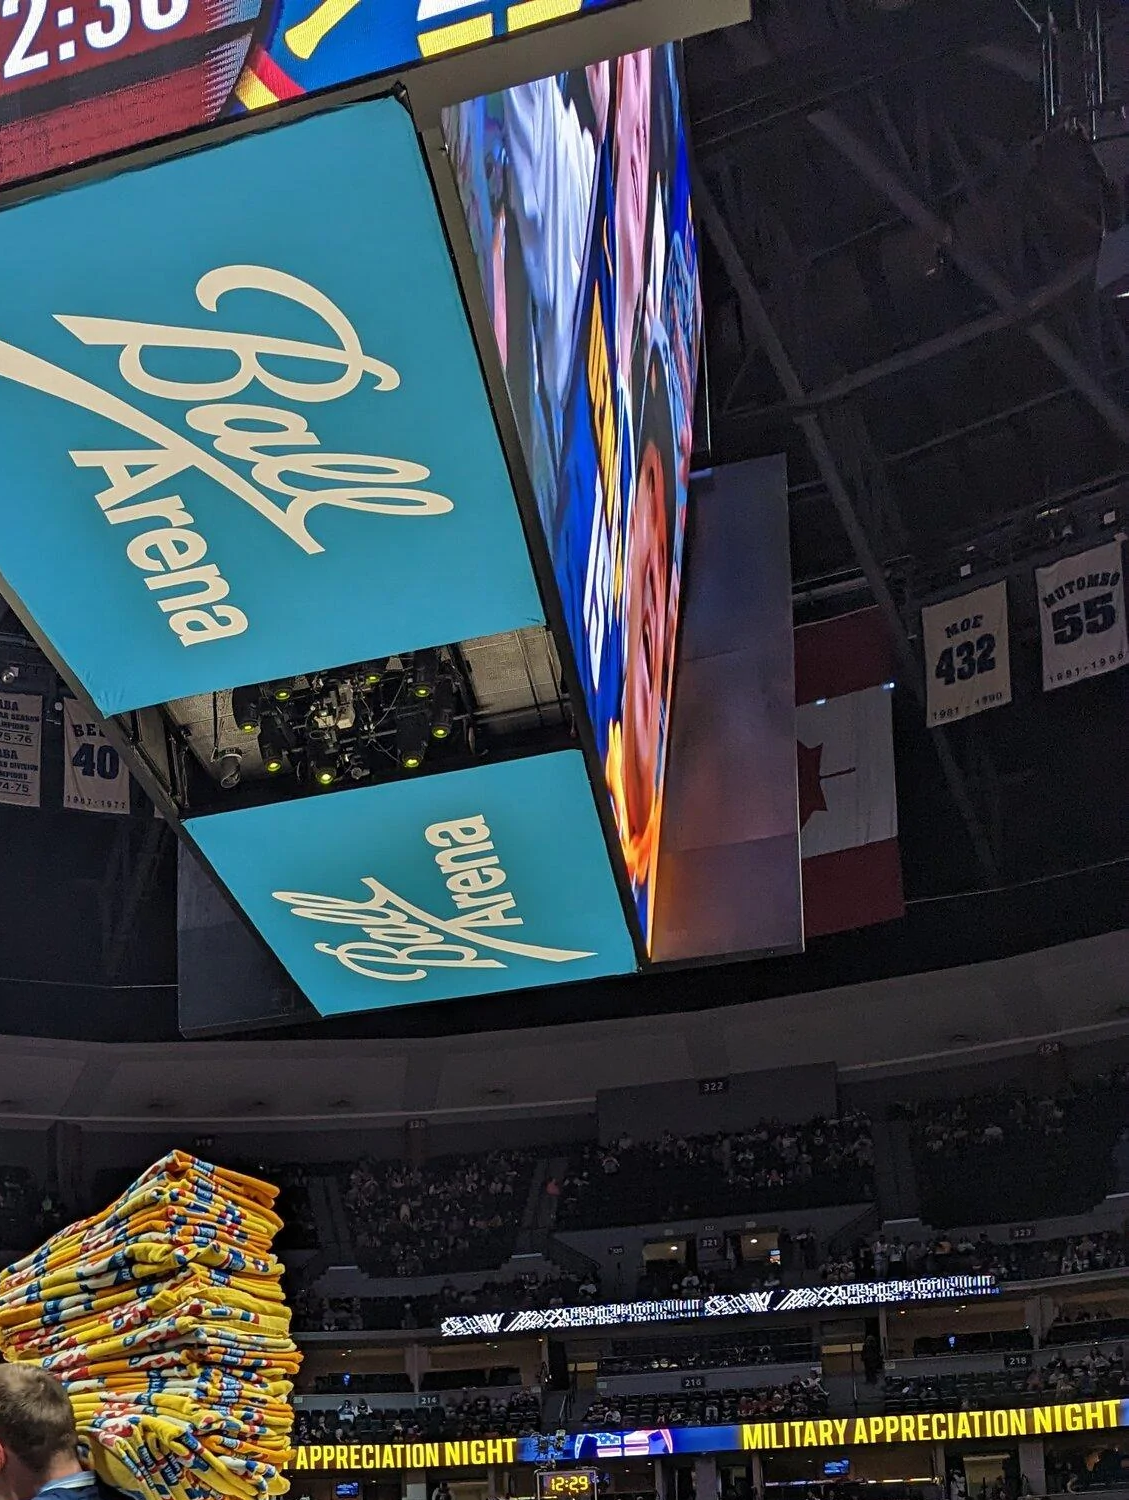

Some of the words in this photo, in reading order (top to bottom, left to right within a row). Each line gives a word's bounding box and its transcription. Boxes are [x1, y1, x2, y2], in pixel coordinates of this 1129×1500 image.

[52, 264, 455, 545] Ball
[68, 448, 249, 648] Arena
[1042, 571, 1121, 609] MUTOMBO
[944, 614, 984, 639] MOE
[1051, 592, 1117, 646] 55
[935, 633, 997, 686] 432
[10, 761, 39, 772] DIVISION
[73, 742, 120, 780] 40
[424, 813, 524, 928] Arena
[271, 879, 508, 982] Ball
[704, 1082, 723, 1091] 322
[702, 1239, 717, 1247] 321
[1010, 1357, 1027, 1365] 218
[743, 1419, 850, 1451] MILITARY
[854, 1409, 1027, 1444] APPRECIATION
[1034, 1399, 1122, 1433] NIGHT
[296, 1442, 439, 1470] APPRECIATION
[445, 1437, 518, 1467] NIGHT
[550, 1475, 589, 1491] 12:29
